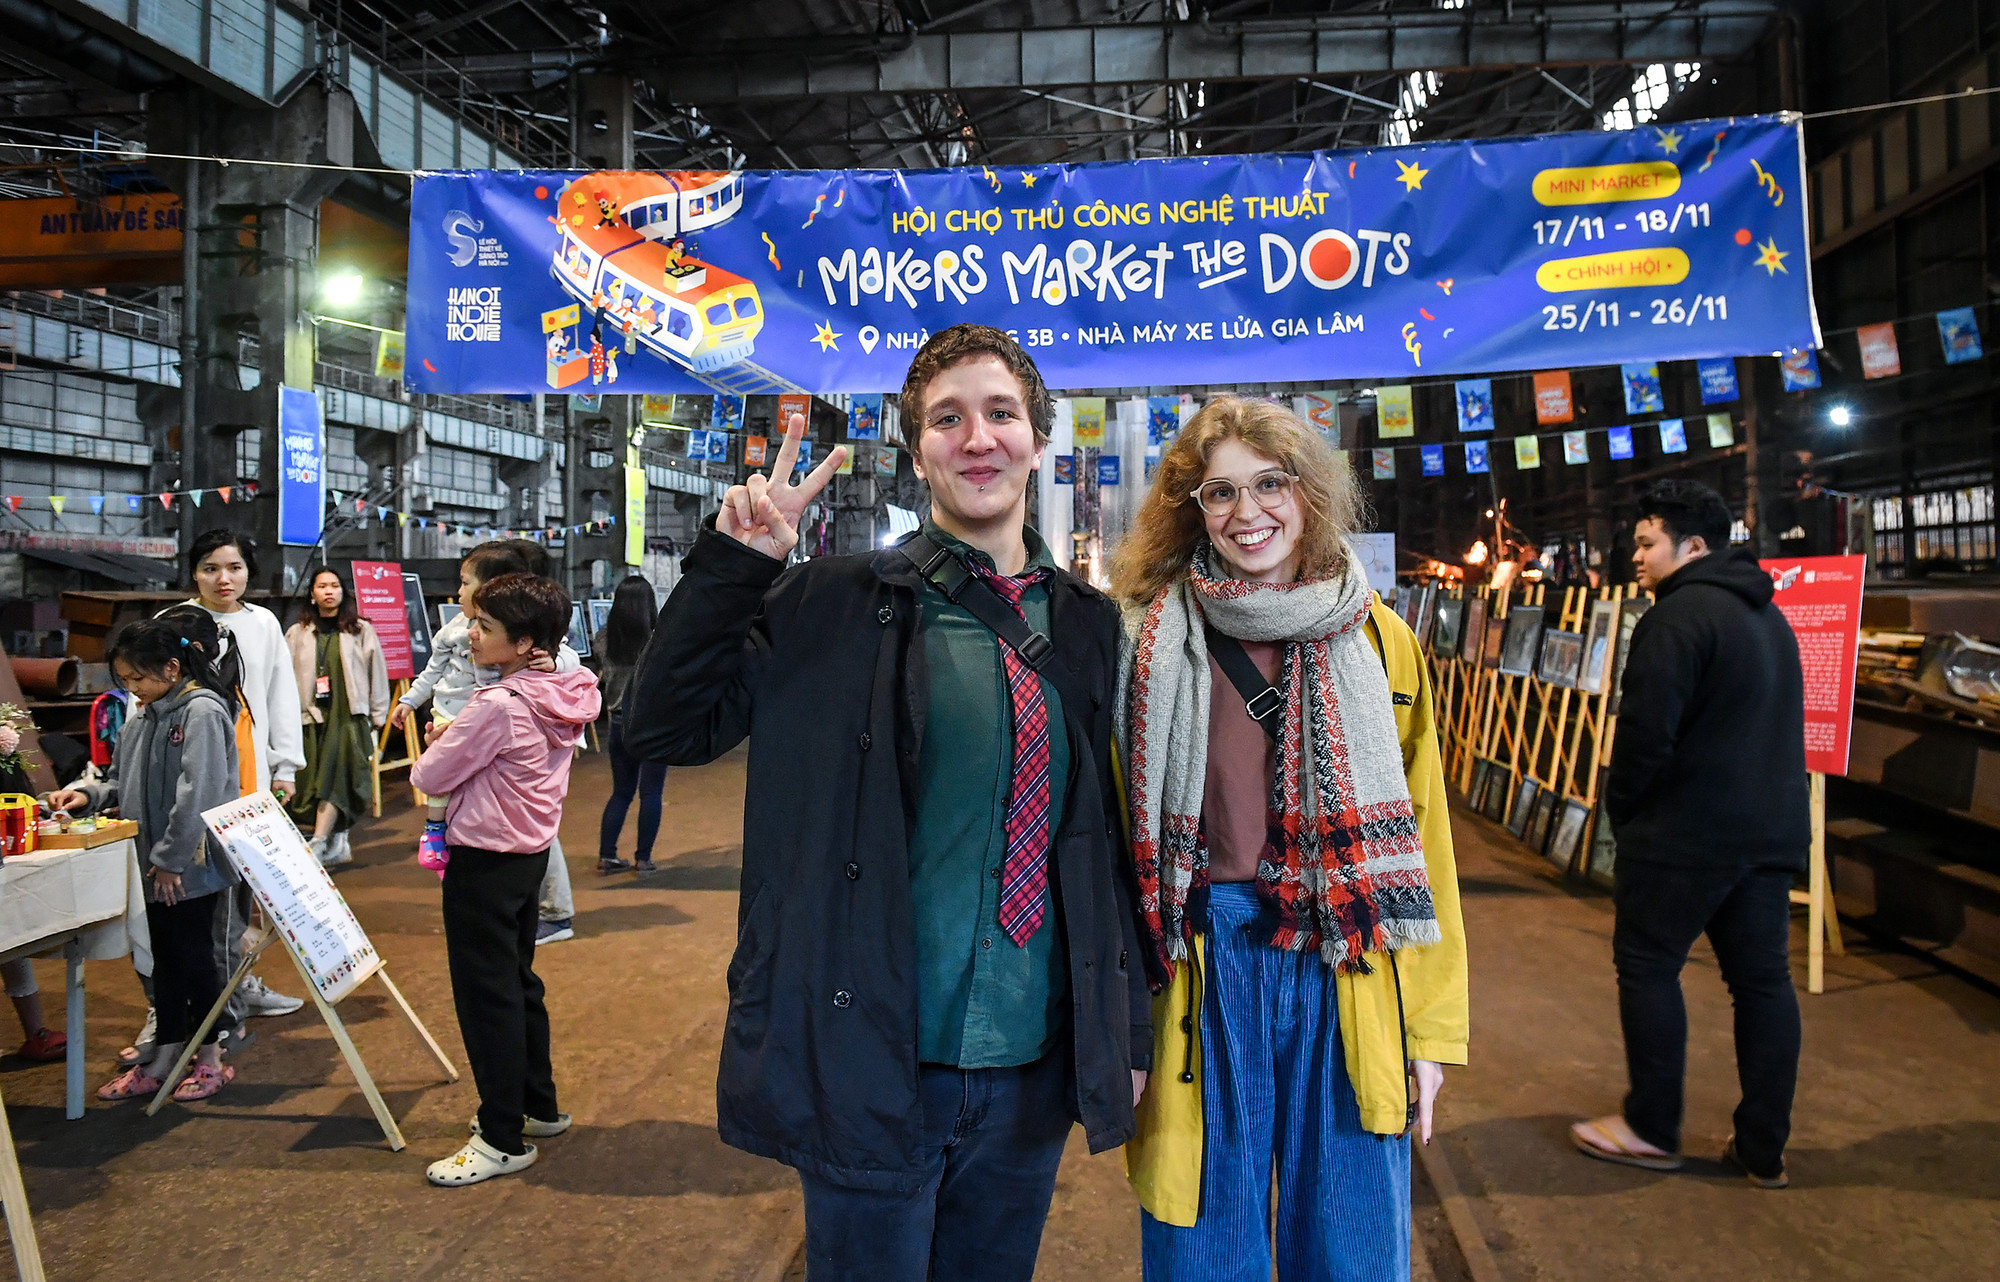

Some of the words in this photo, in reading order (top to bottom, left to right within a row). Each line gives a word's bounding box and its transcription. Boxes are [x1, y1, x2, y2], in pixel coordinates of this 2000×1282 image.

[1550, 178, 1585, 194] MINI
[1591, 172, 1662, 192] MARKET
[40, 213, 67, 235] AN
[893, 206, 936, 236] HỘI
[945, 206, 1003, 236] CHỢ
[1011, 200, 1065, 231] THỦ
[1073, 199, 1150, 227] CÔNG
[1160, 194, 1234, 226] NGHỆ
[1242, 188, 1330, 220] THUẬT
[1533, 215, 1605, 247] 17/11
[1635, 202, 1711, 234] 18/11
[1567, 260, 1624, 281] CHÍNH
[1630, 256, 1661, 278] HỘI
[886, 328, 930, 350] NHÀ
[1027, 328, 1054, 347] 3B
[1078, 321, 1125, 345] NHÀ
[1133, 319, 1178, 343] MÁY
[1185, 322, 1213, 341] XE
[1221, 315, 1264, 339] LỬA
[1271, 318, 1310, 337] GIA
[1317, 312, 1364, 335] LÂM
[1542, 300, 1619, 333] 25/11
[1651, 294, 1728, 327] 26/11
